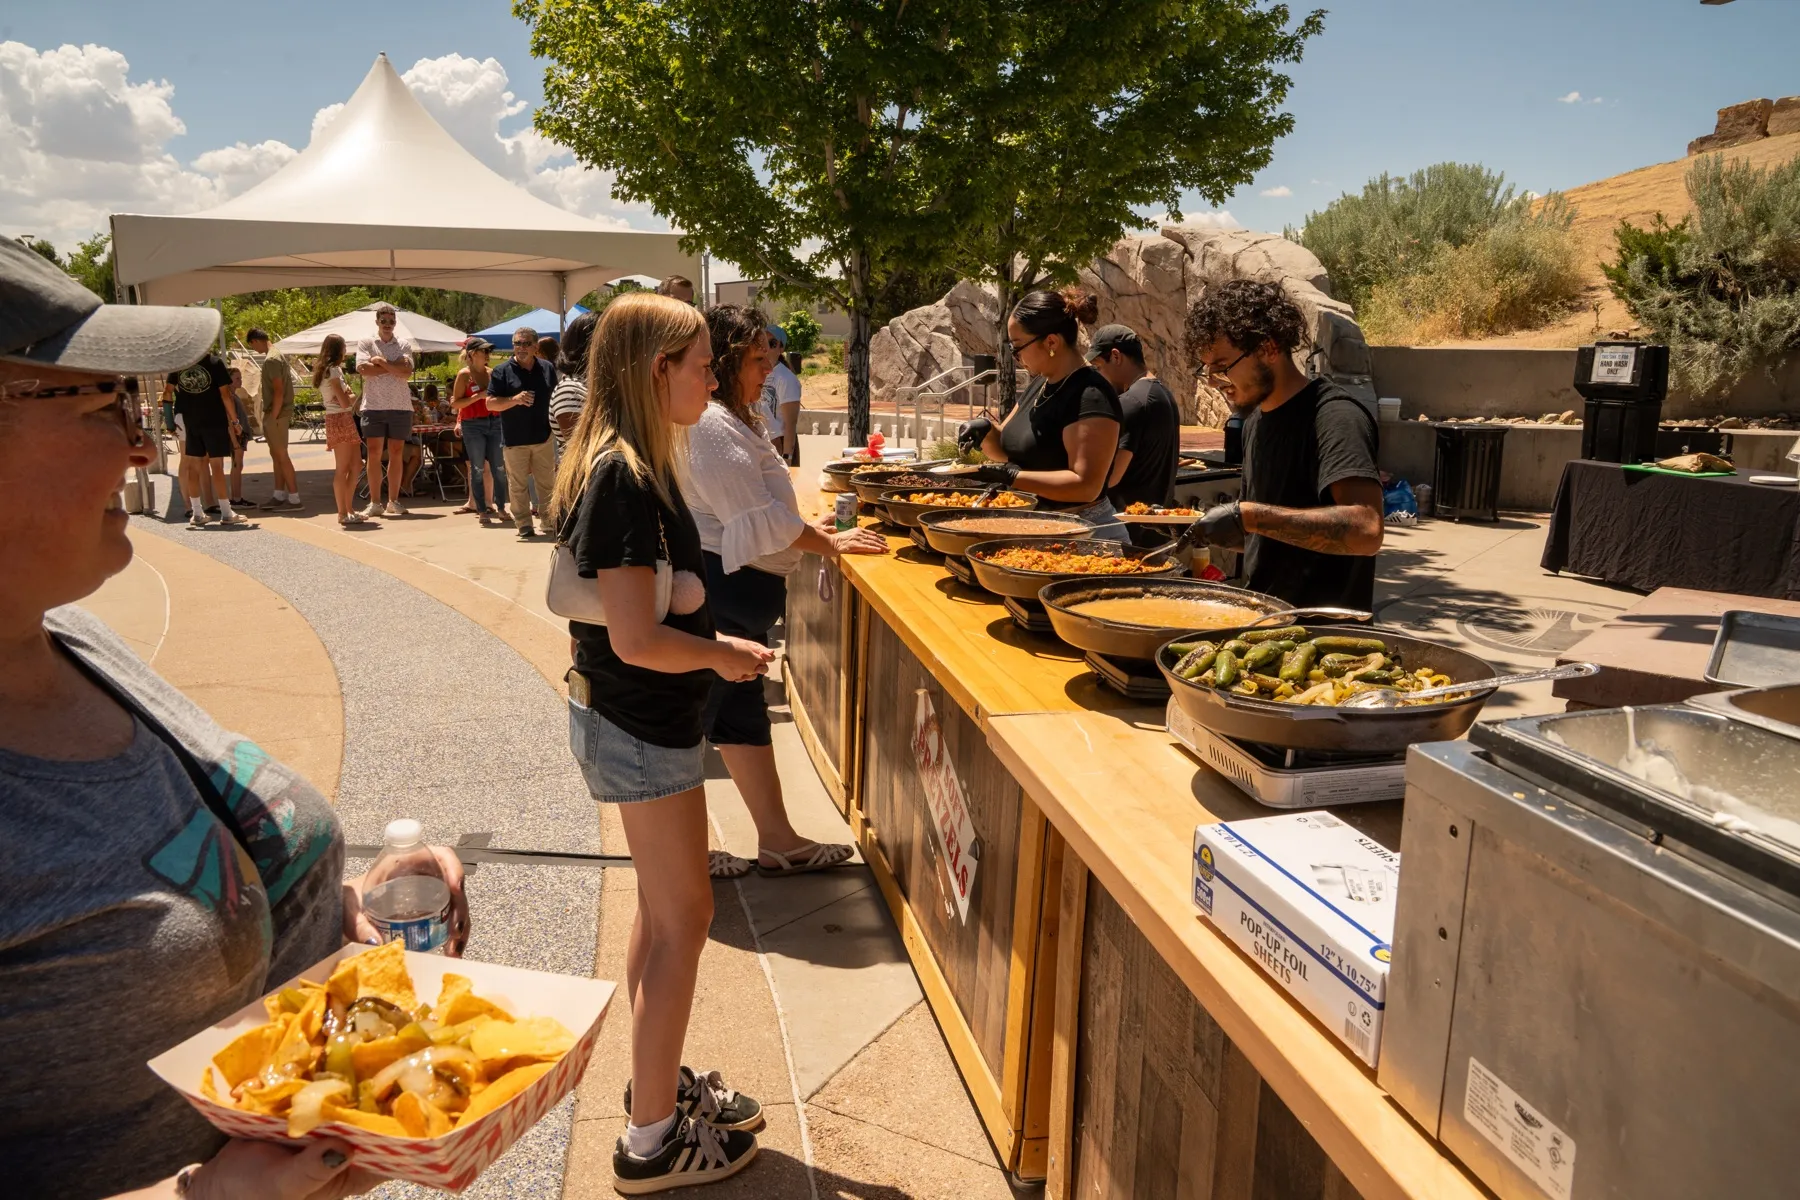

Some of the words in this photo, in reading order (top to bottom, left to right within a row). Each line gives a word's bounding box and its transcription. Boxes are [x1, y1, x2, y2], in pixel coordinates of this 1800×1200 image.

[916, 724, 969, 898] PRETZELS
[943, 763, 966, 832] SOFT
[1354, 838, 1399, 862] SHEETS
[1240, 910, 1281, 954] POP-UP
[1283, 947, 1309, 982] FOIL
[1253, 940, 1291, 985] SHEETS
[1320, 944, 1336, 961] 12"
[1336, 955, 1344, 971] X
[1346, 964, 1377, 993] 10.75"
